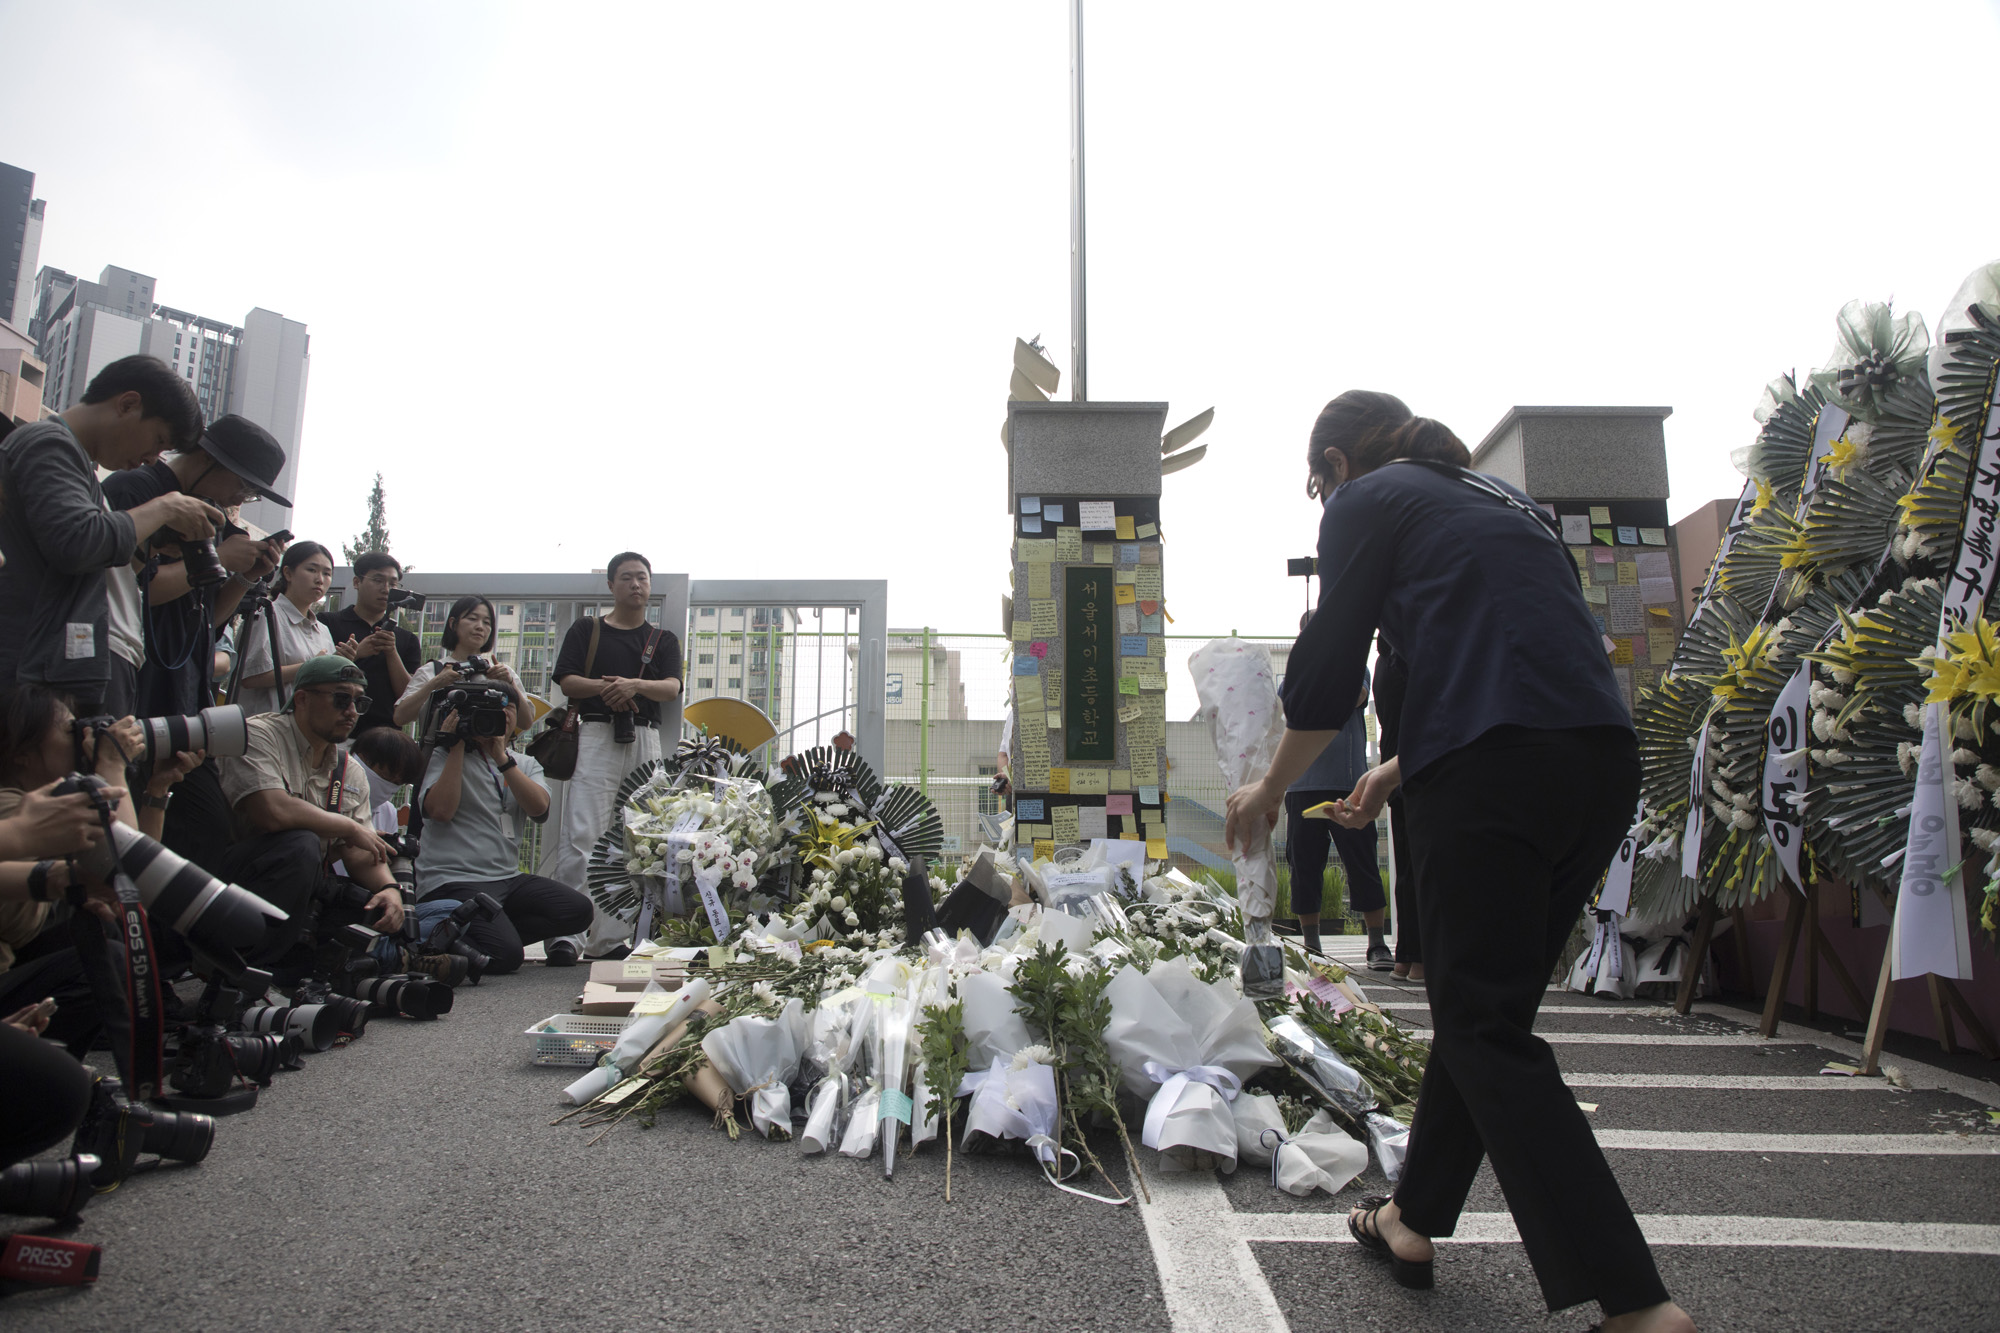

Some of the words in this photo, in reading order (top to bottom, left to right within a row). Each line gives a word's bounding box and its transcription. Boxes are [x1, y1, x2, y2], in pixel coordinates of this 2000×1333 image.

[1081, 580, 1099, 746] 서울서이초등학교
[328, 780, 341, 805] Canon
[126, 910, 144, 951] EOS
[132, 954, 149, 976] 5D
[16, 1246, 75, 1268] PRESS
